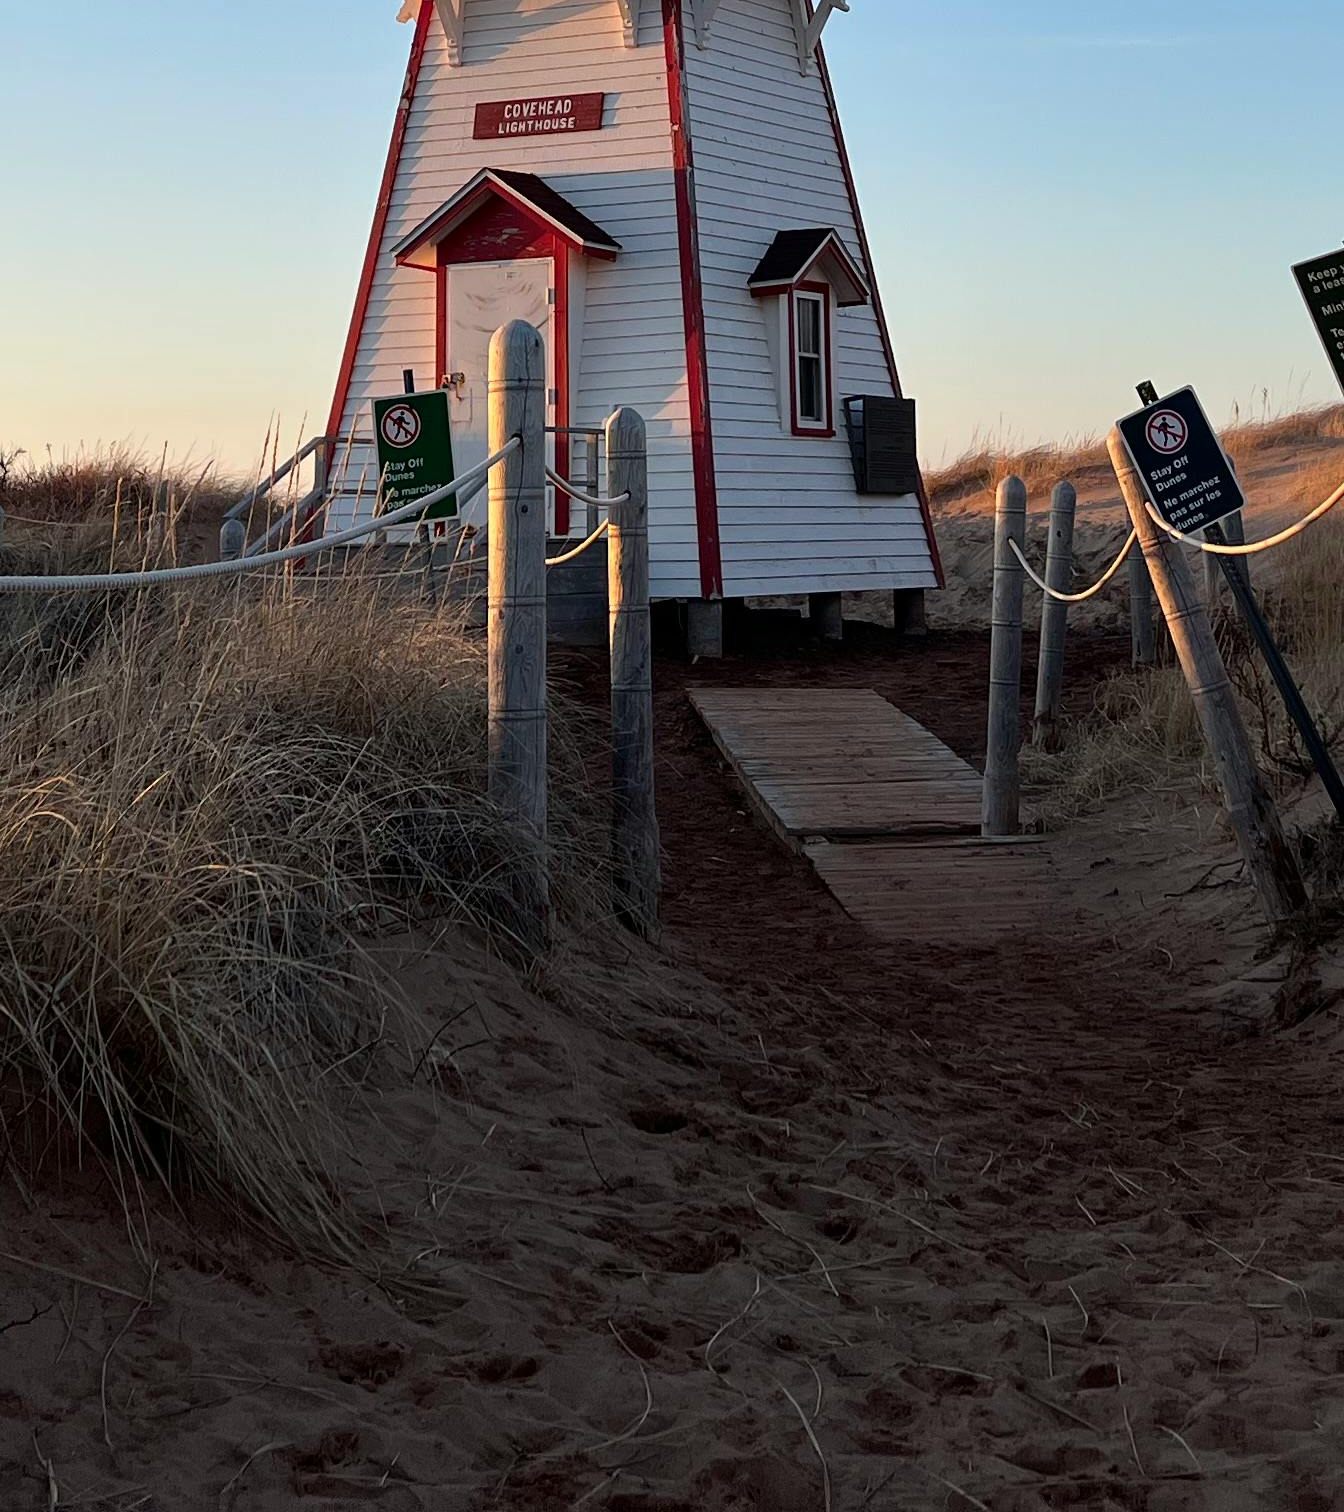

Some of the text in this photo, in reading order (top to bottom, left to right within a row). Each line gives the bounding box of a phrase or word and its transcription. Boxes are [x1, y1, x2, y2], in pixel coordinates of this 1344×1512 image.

[504, 99, 572, 119] COVEHEAD
[498, 117, 576, 134] LIGHTHOUSE
[1307, 267, 1338, 282] Keep
[1313, 285, 1321, 294] a
[408, 458, 424, 468] Off
[1150, 454, 1189, 481] Stay Off
[385, 471, 415, 483] Dunes
[1156, 471, 1187, 492] Dunes
[1163, 475, 1221, 509] Ne marchez
[1169, 489, 1222, 521] pas sur les
